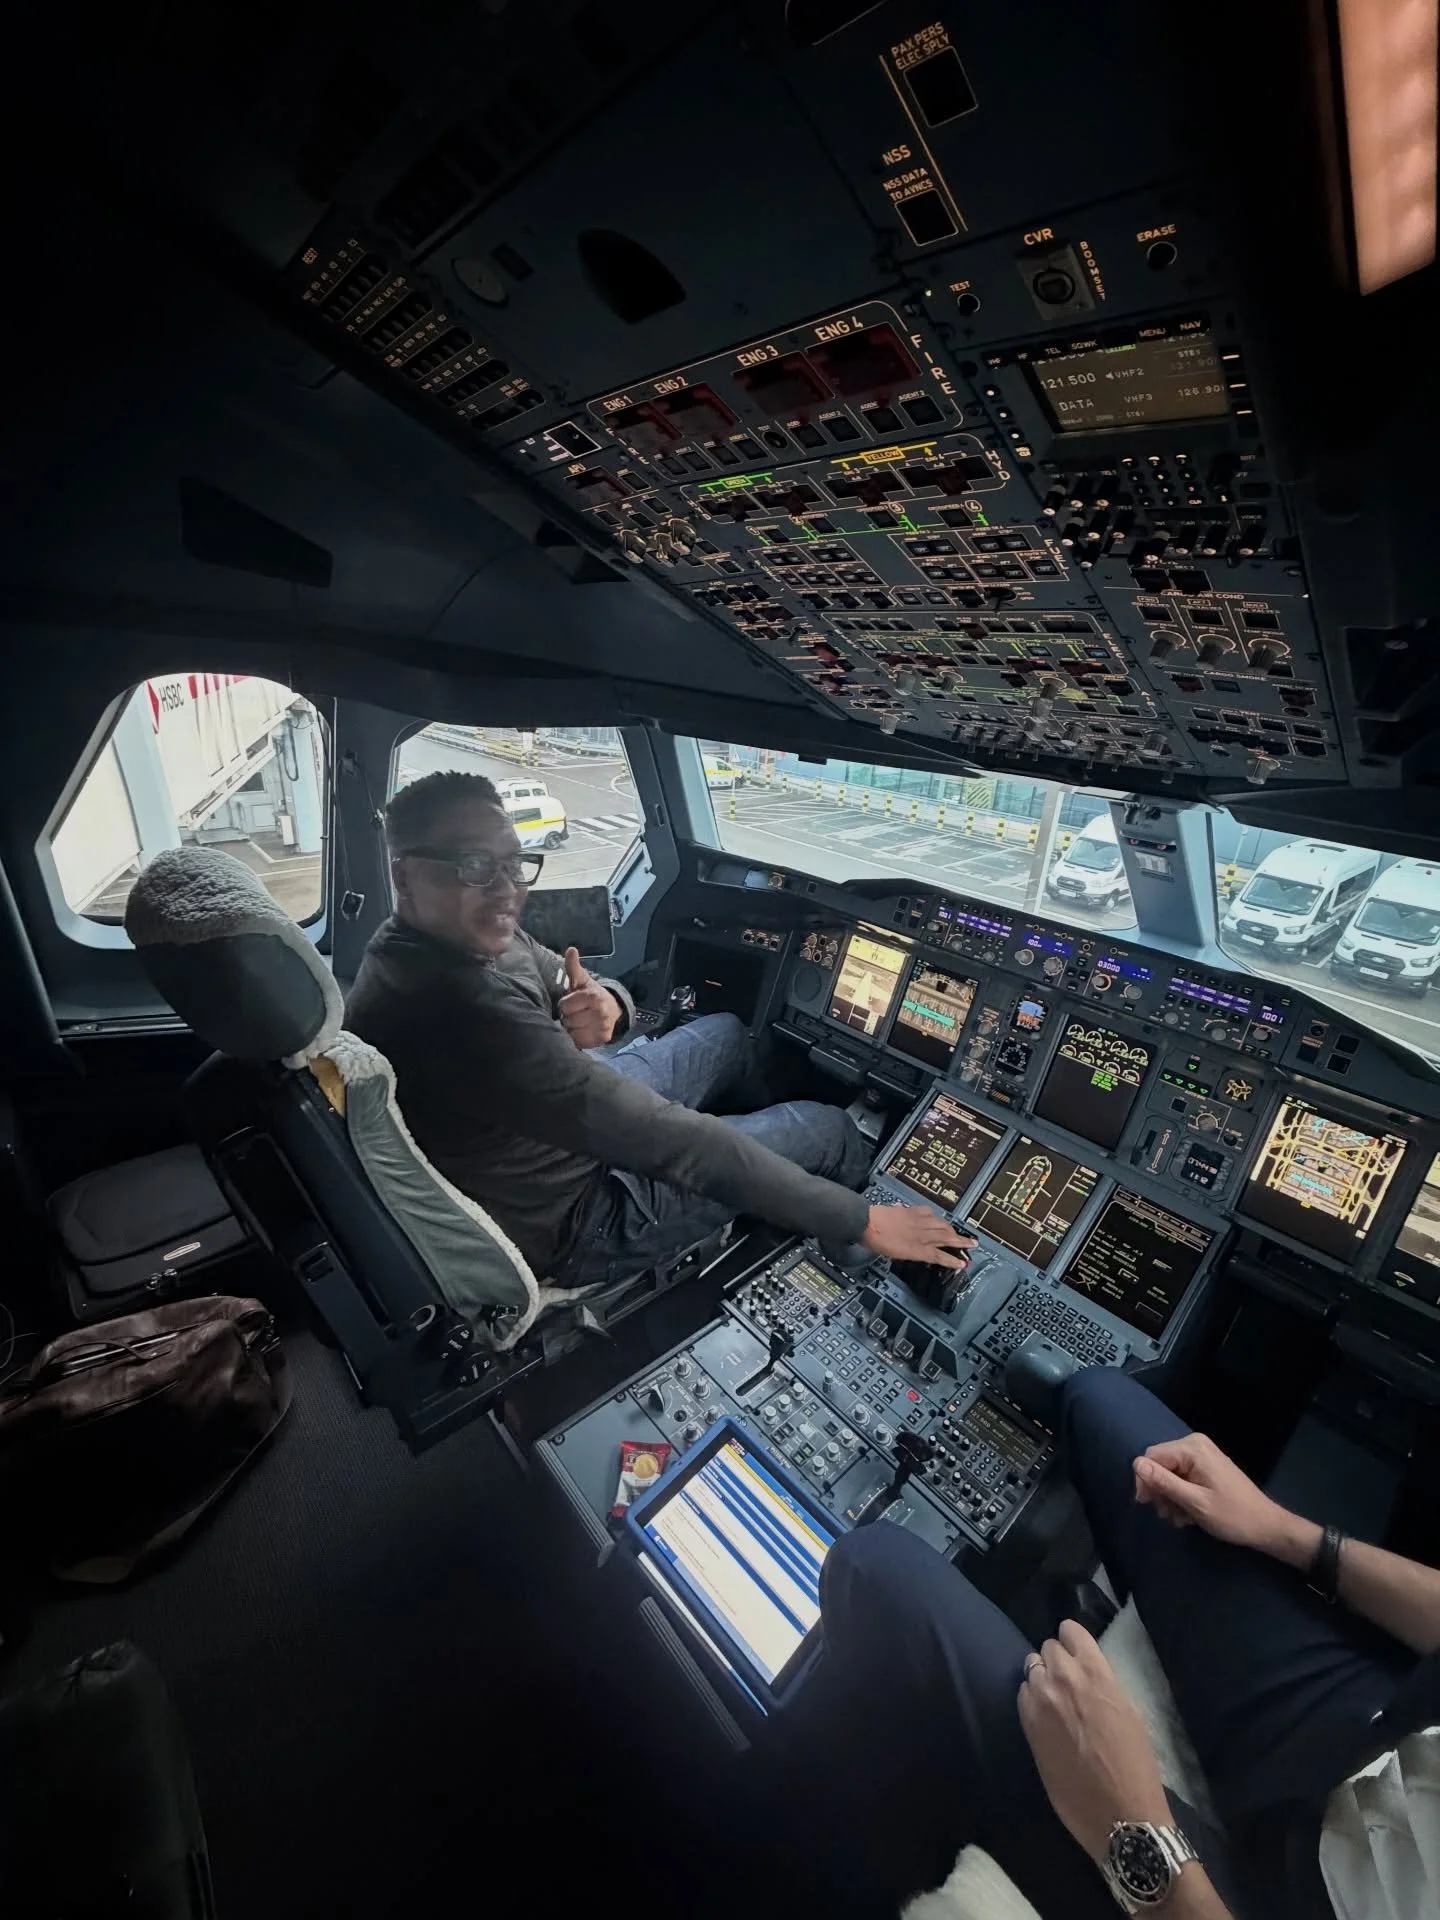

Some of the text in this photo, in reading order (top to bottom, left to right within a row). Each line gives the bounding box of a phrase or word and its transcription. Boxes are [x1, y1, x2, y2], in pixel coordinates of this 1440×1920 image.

[891, 21, 945, 58] PAX PERS
[895, 32, 951, 70] ELEC SPLY
[882, 145, 912, 166] NSS
[883, 167, 929, 192] NSS DATA
[890, 191, 903, 203] TO
[1023, 226, 1055, 247] CVR
[1136, 224, 1177, 243] ERASE
[949, 280, 971, 293] TEST
[814, 315, 864, 341] ENG 4
[1179, 320, 1203, 331] NAV
[736, 344, 779, 367] ENG 3
[910, 333, 957, 395] FIRE
[1114, 367, 1145, 379] VHF2
[654, 376, 689, 394] ENG 2
[603, 394, 633, 411] ENG 1
[1058, 399, 1096, 412] DATA
[1123, 393, 1153, 404] VHF3
[866, 449, 902, 462] YELLOW
[985, 450, 1011, 481] HYD
[1203, 670, 1268, 682] CARGO SMOKE
[159, 683, 185, 712] HSBC
